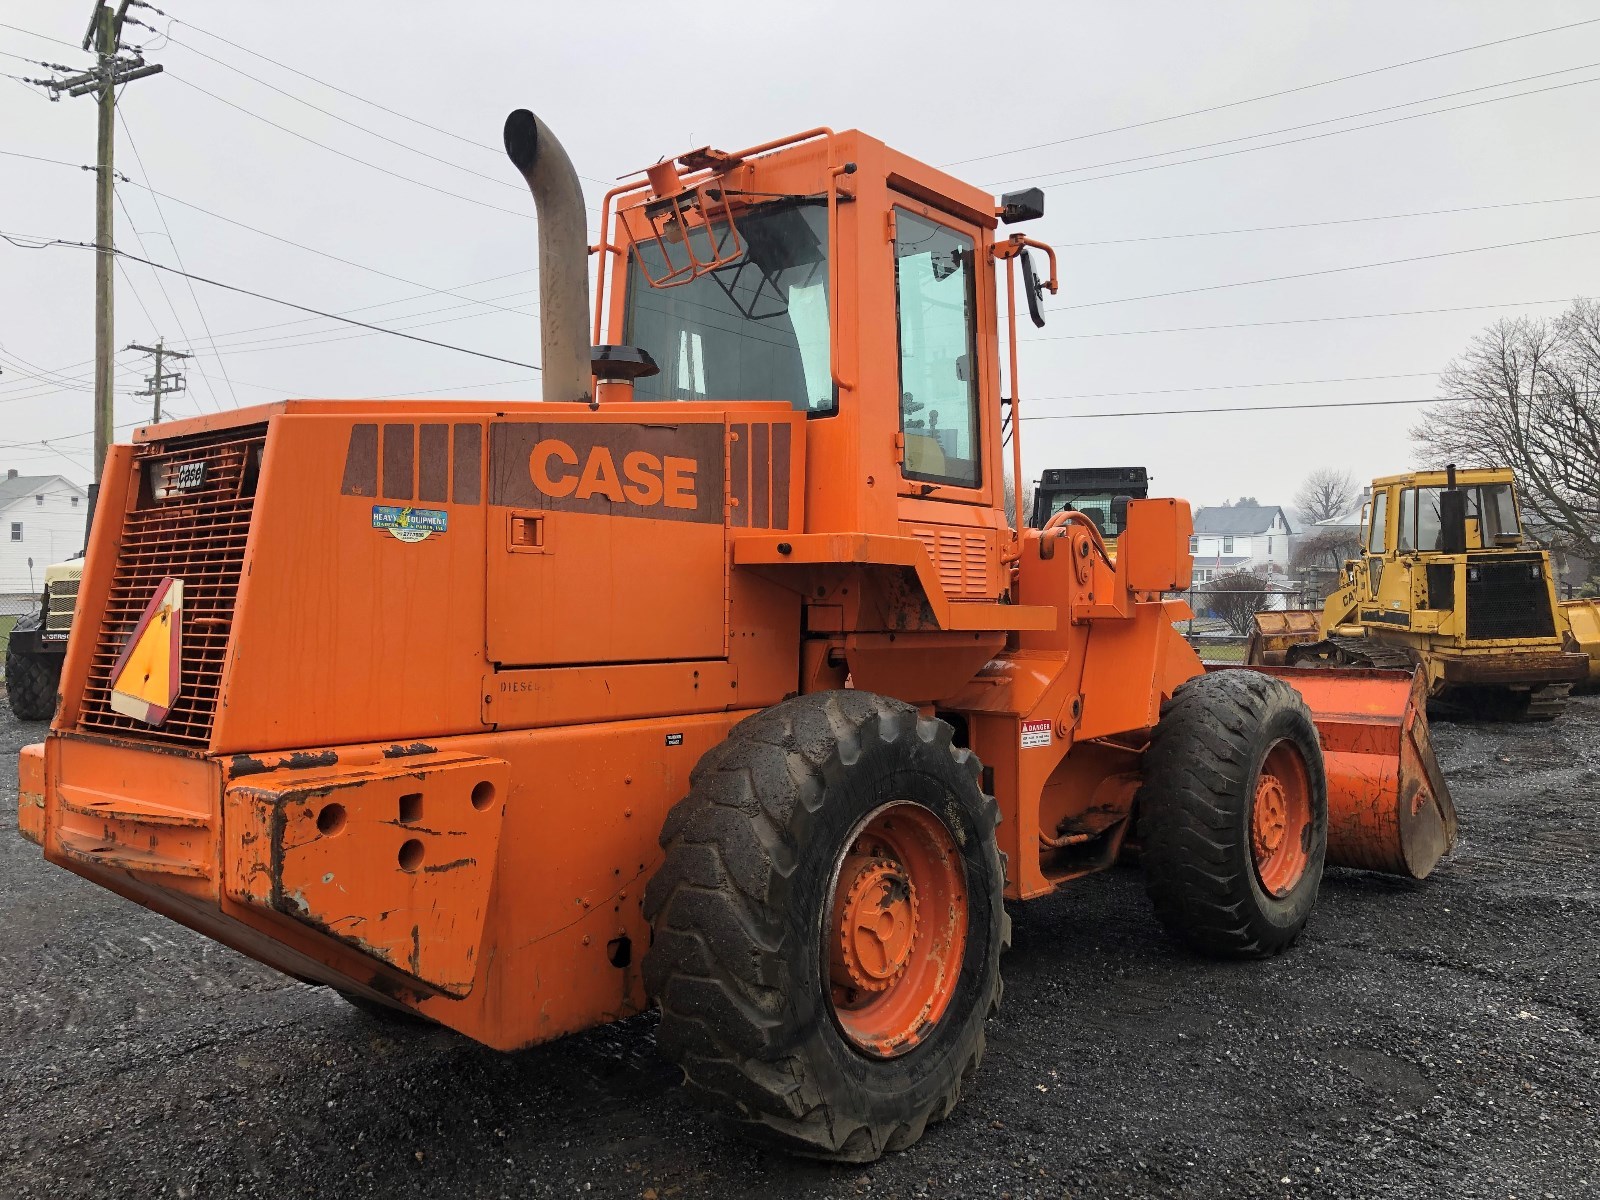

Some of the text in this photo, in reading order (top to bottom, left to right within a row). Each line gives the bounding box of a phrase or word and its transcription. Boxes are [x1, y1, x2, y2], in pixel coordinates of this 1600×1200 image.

[528, 438, 698, 510] CASE
[373, 513, 398, 522] HEAVY
[500, 681, 541, 692] DIESEL
[1028, 723, 1050, 732] DANGER
